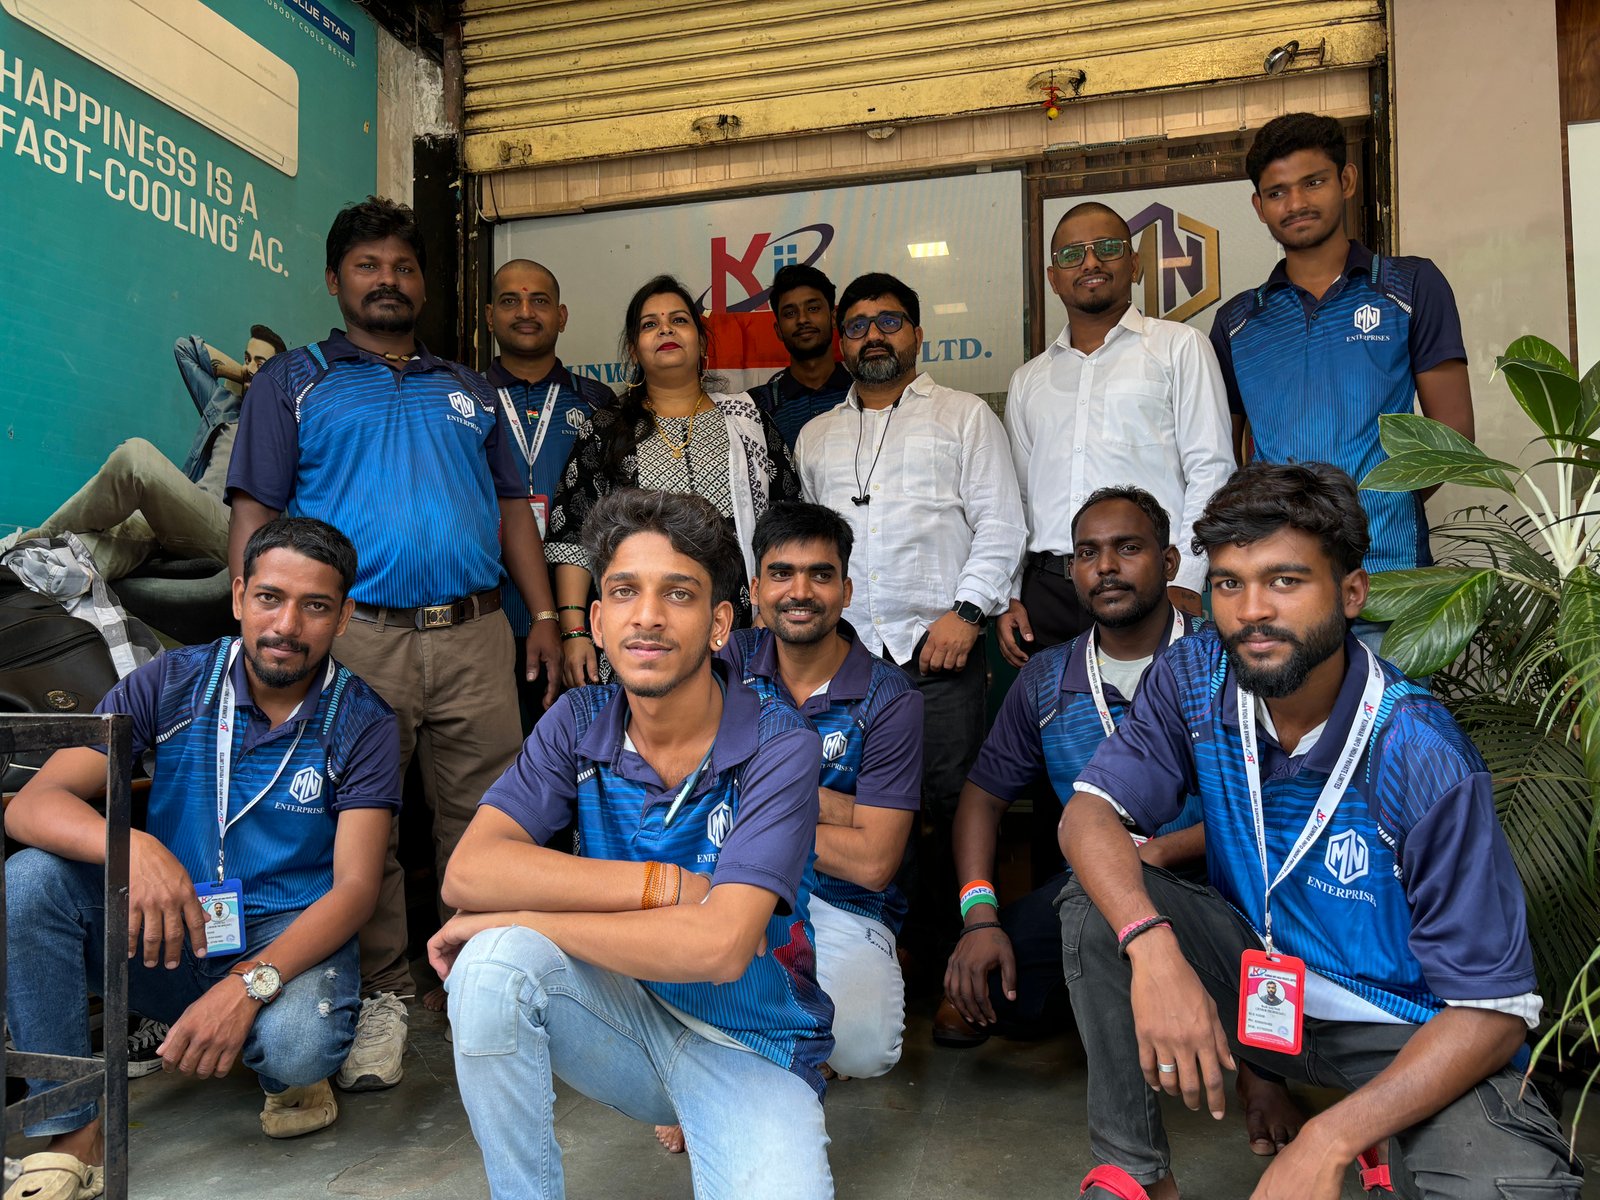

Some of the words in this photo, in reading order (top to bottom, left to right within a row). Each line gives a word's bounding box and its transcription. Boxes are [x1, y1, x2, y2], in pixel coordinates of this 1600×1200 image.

[264, 0, 296, 23] OBODY
[299, 22, 324, 46] COOLS
[293, 0, 320, 21] LUE
[322, 15, 350, 44] STAR
[0, 48, 197, 188] HAPPINESS
[206, 160, 233, 206] IS
[240, 182, 259, 221] A
[249, 229, 289, 278] AC.
[921, 338, 993, 363] LTD.
[1346, 333, 1391, 342] ENTERPRISES
